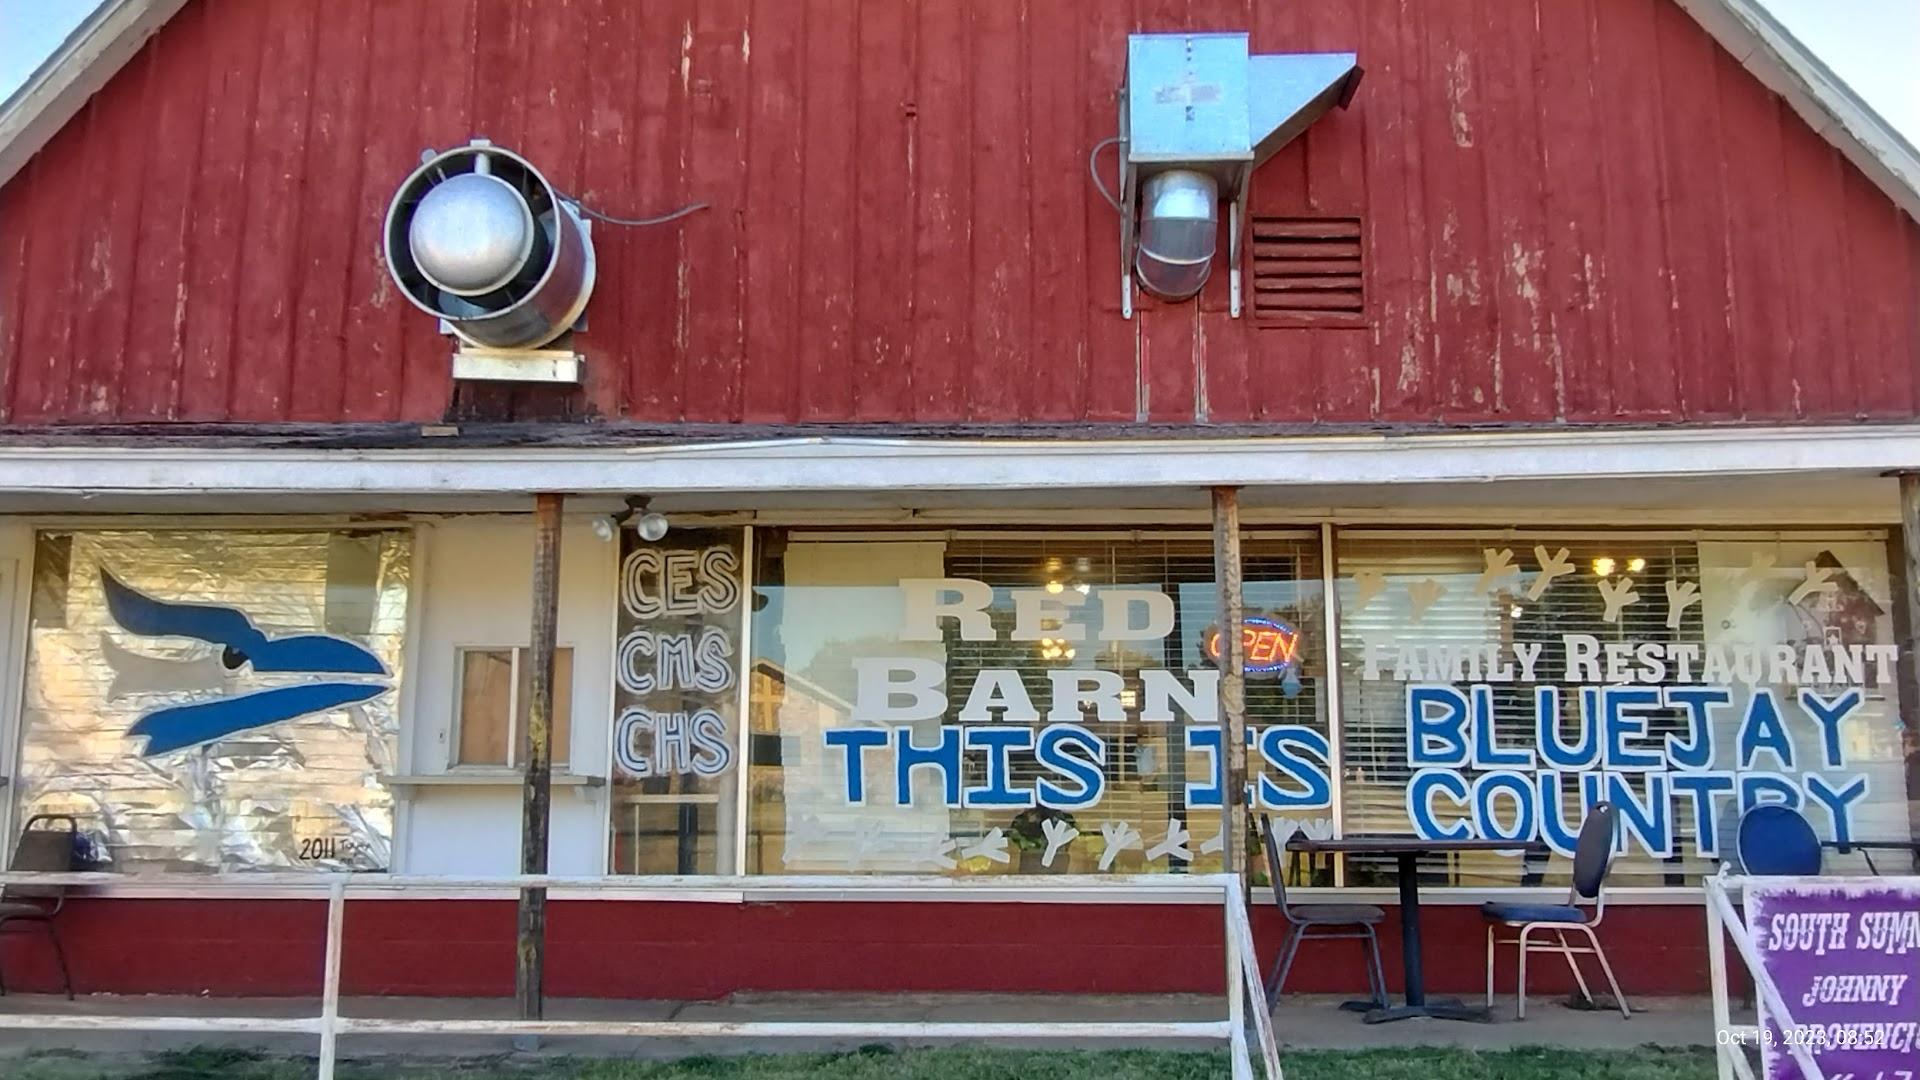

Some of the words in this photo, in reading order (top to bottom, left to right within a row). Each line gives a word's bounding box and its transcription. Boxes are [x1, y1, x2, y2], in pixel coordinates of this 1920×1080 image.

[622, 546, 740, 619] CES
[899, 578, 1176, 642] RED
[617, 627, 733, 695] CMS
[851, 657, 1220, 722] BARN
[1361, 635, 1542, 681] FAMILY
[1563, 634, 1899, 684] RESTAURANT
[615, 706, 736, 778] CHS
[1406, 684, 1864, 772] BLUEJAY
[824, 724, 1106, 810] THIS
[1184, 724, 1334, 811] IS
[299, 837, 335, 860] 2011
[1768, 912, 1851, 955] SOUTH
[1802, 974, 1908, 1007] JOHNNY
